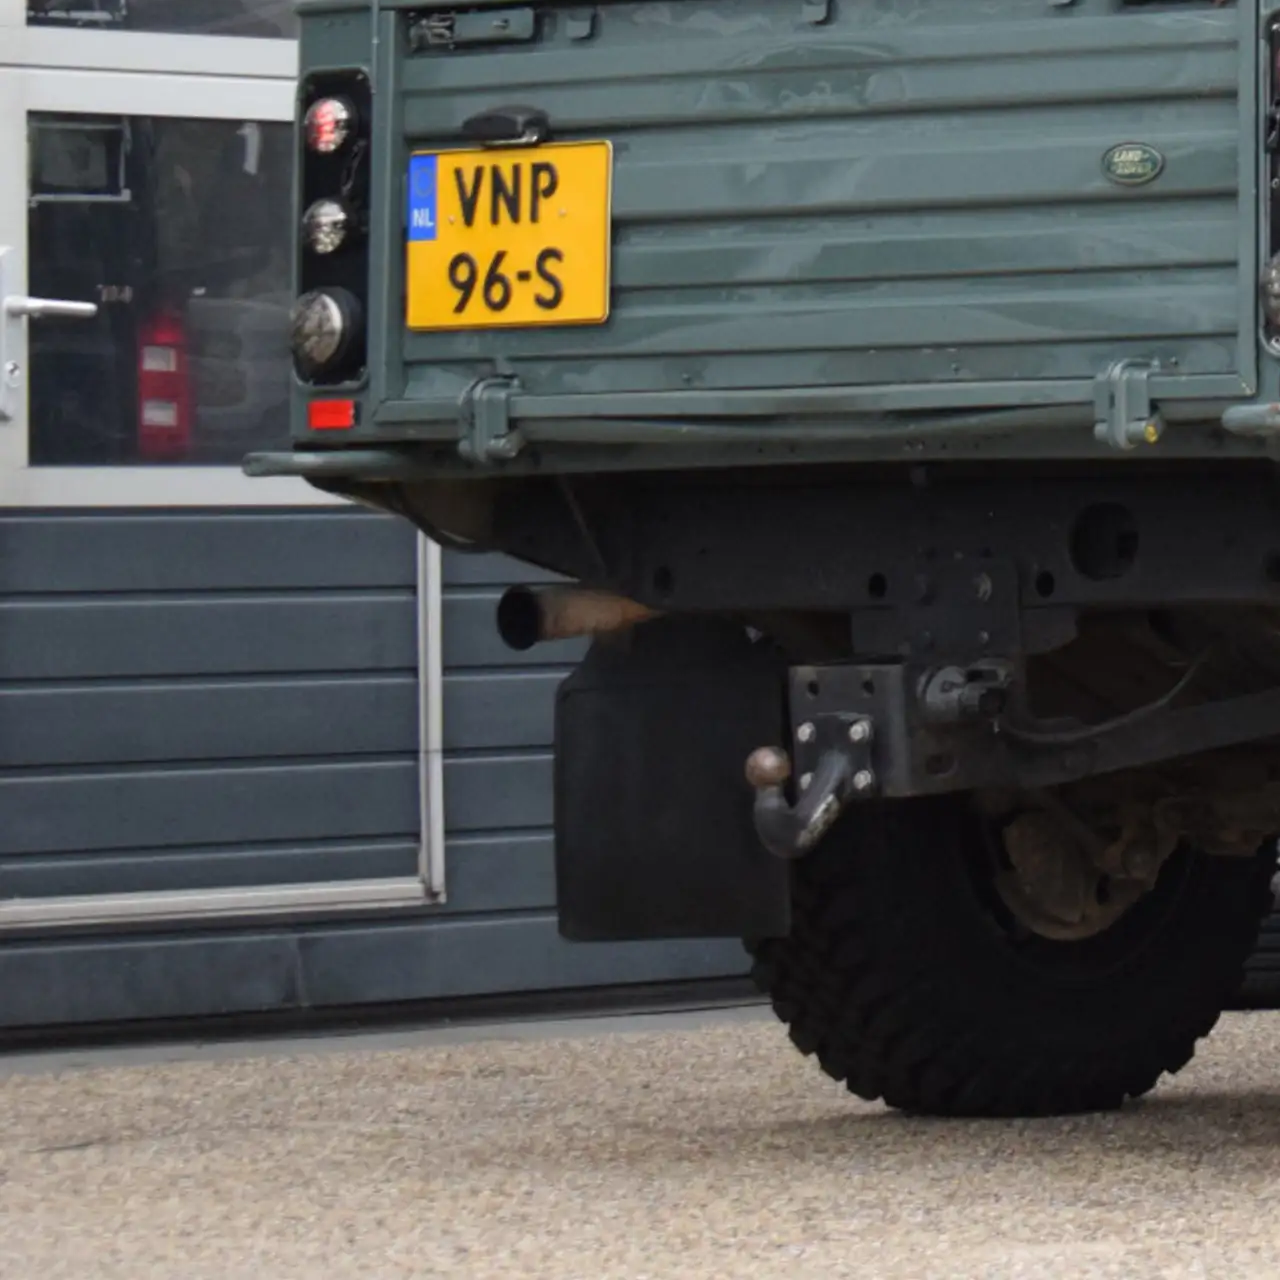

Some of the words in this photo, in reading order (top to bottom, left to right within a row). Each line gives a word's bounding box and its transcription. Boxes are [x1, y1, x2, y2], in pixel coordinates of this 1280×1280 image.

[412, 207, 434, 228] NL
[454, 161, 559, 227] VNP
[448, 247, 564, 313] 96-S
